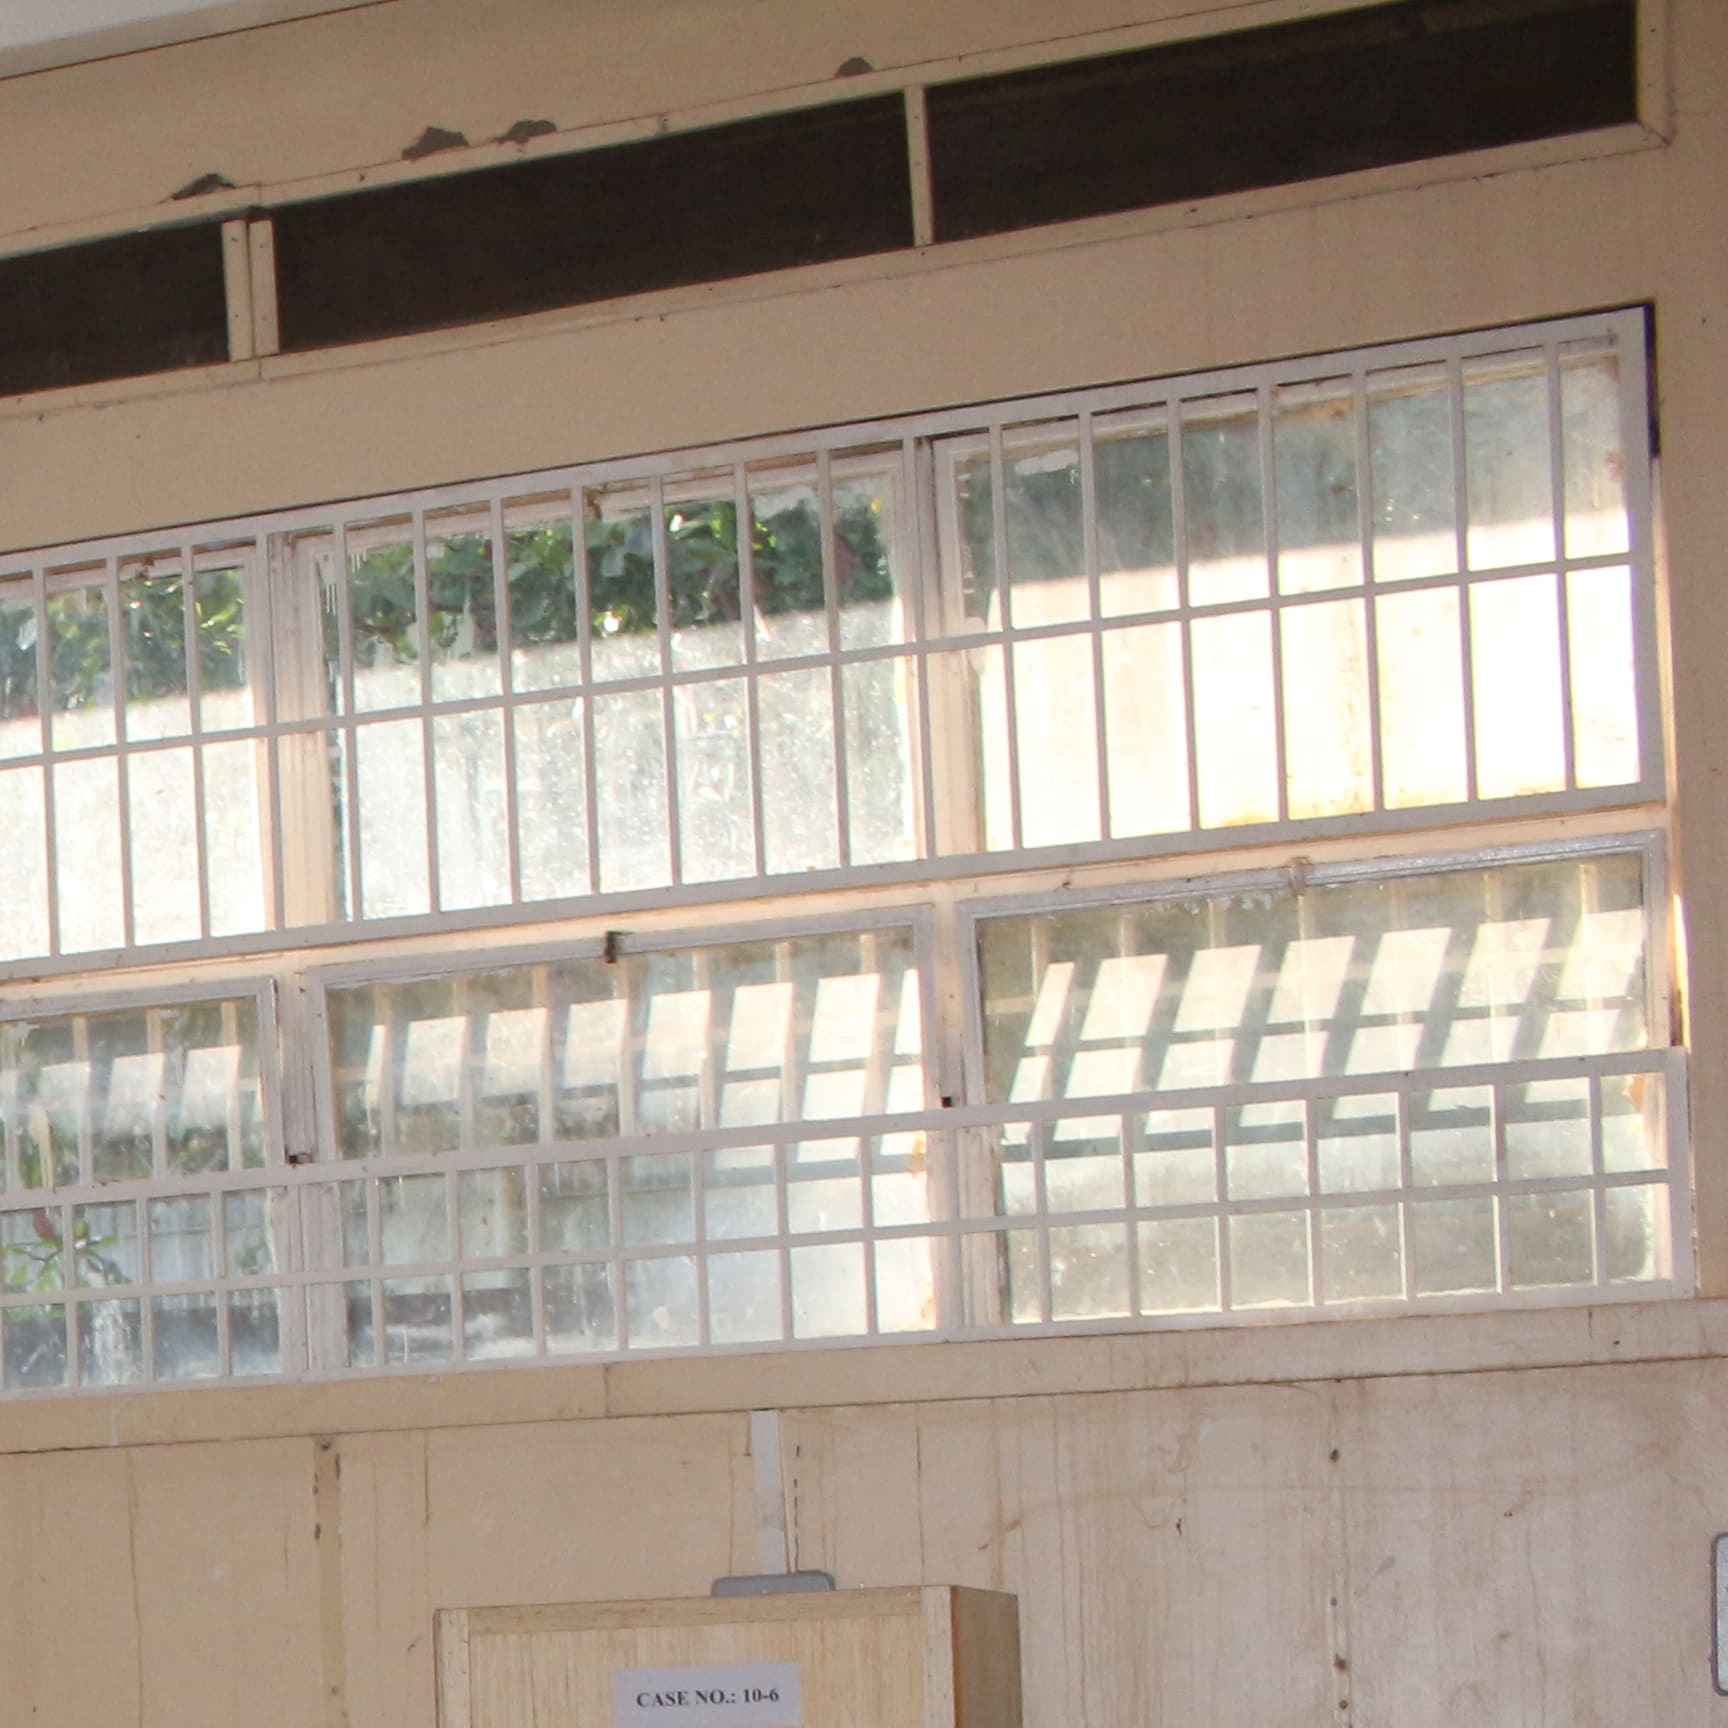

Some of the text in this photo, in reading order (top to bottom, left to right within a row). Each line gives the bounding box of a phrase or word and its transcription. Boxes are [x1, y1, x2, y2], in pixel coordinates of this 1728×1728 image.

[636, 1688, 780, 1708] CASE NO.: 10-6
